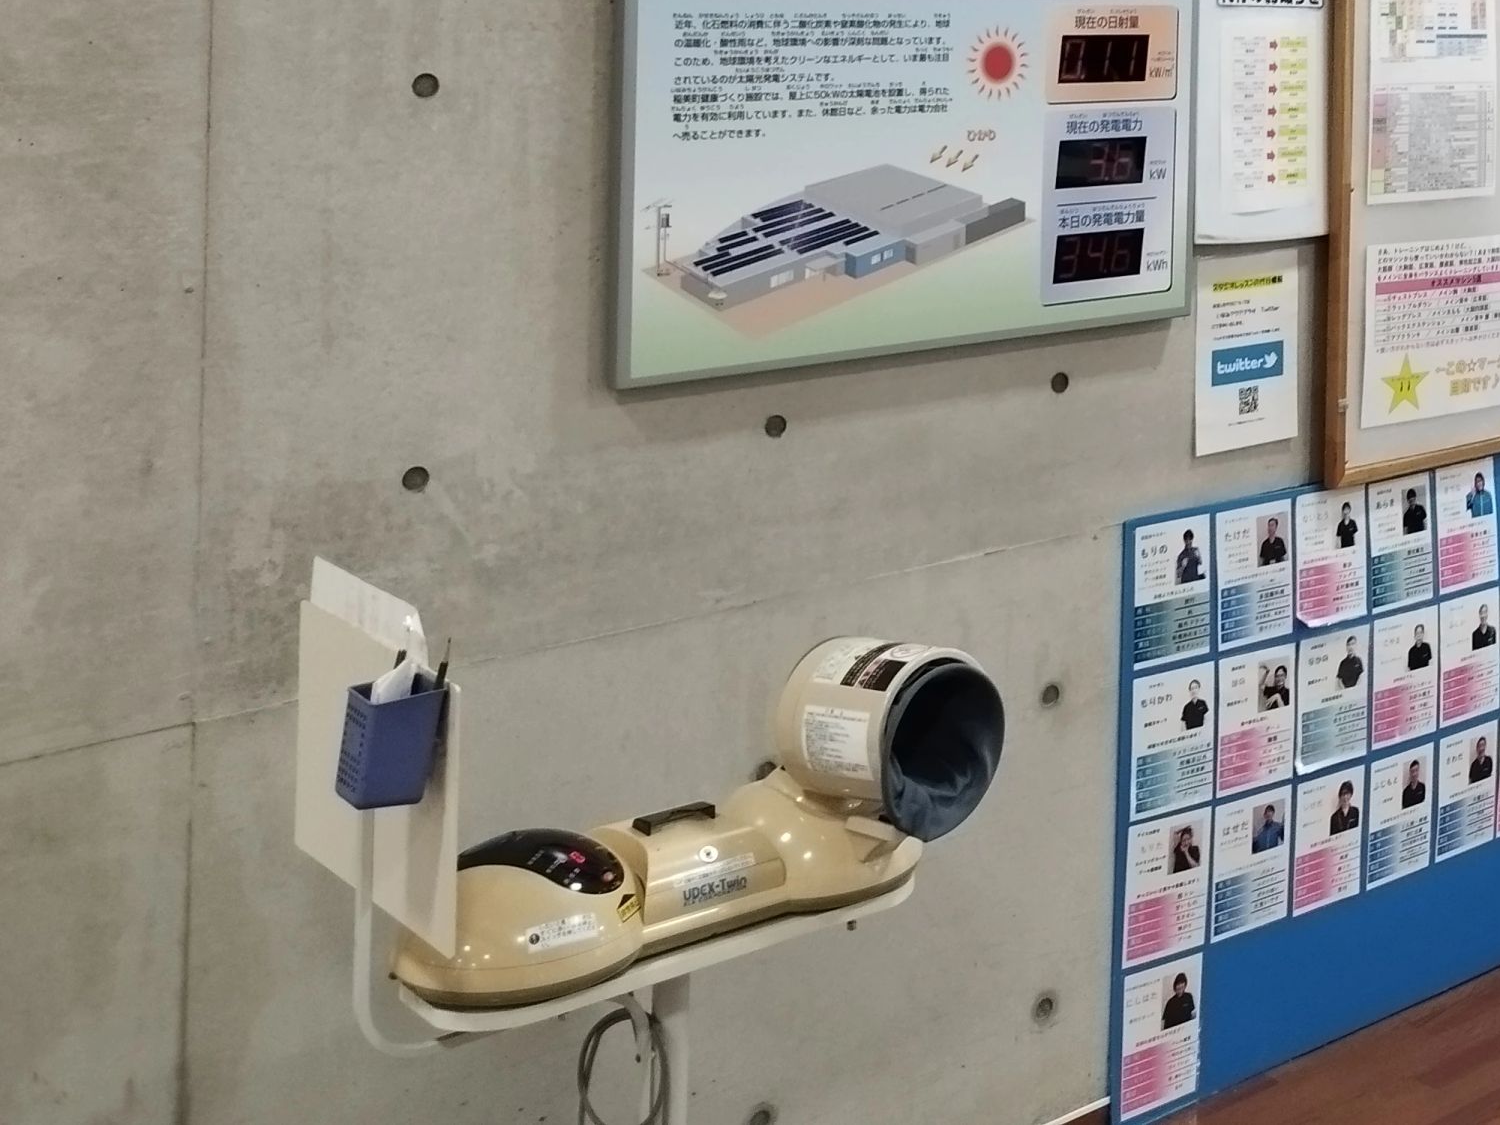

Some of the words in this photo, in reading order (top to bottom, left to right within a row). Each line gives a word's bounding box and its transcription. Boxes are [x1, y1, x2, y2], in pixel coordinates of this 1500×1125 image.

[1074, 14, 1140, 30] 現在の日射量
[1066, 118, 1143, 135] 現在の発電電力
[1058, 210, 1146, 229] 本日の発電電力量
[1216, 355, 1264, 375] twitter
